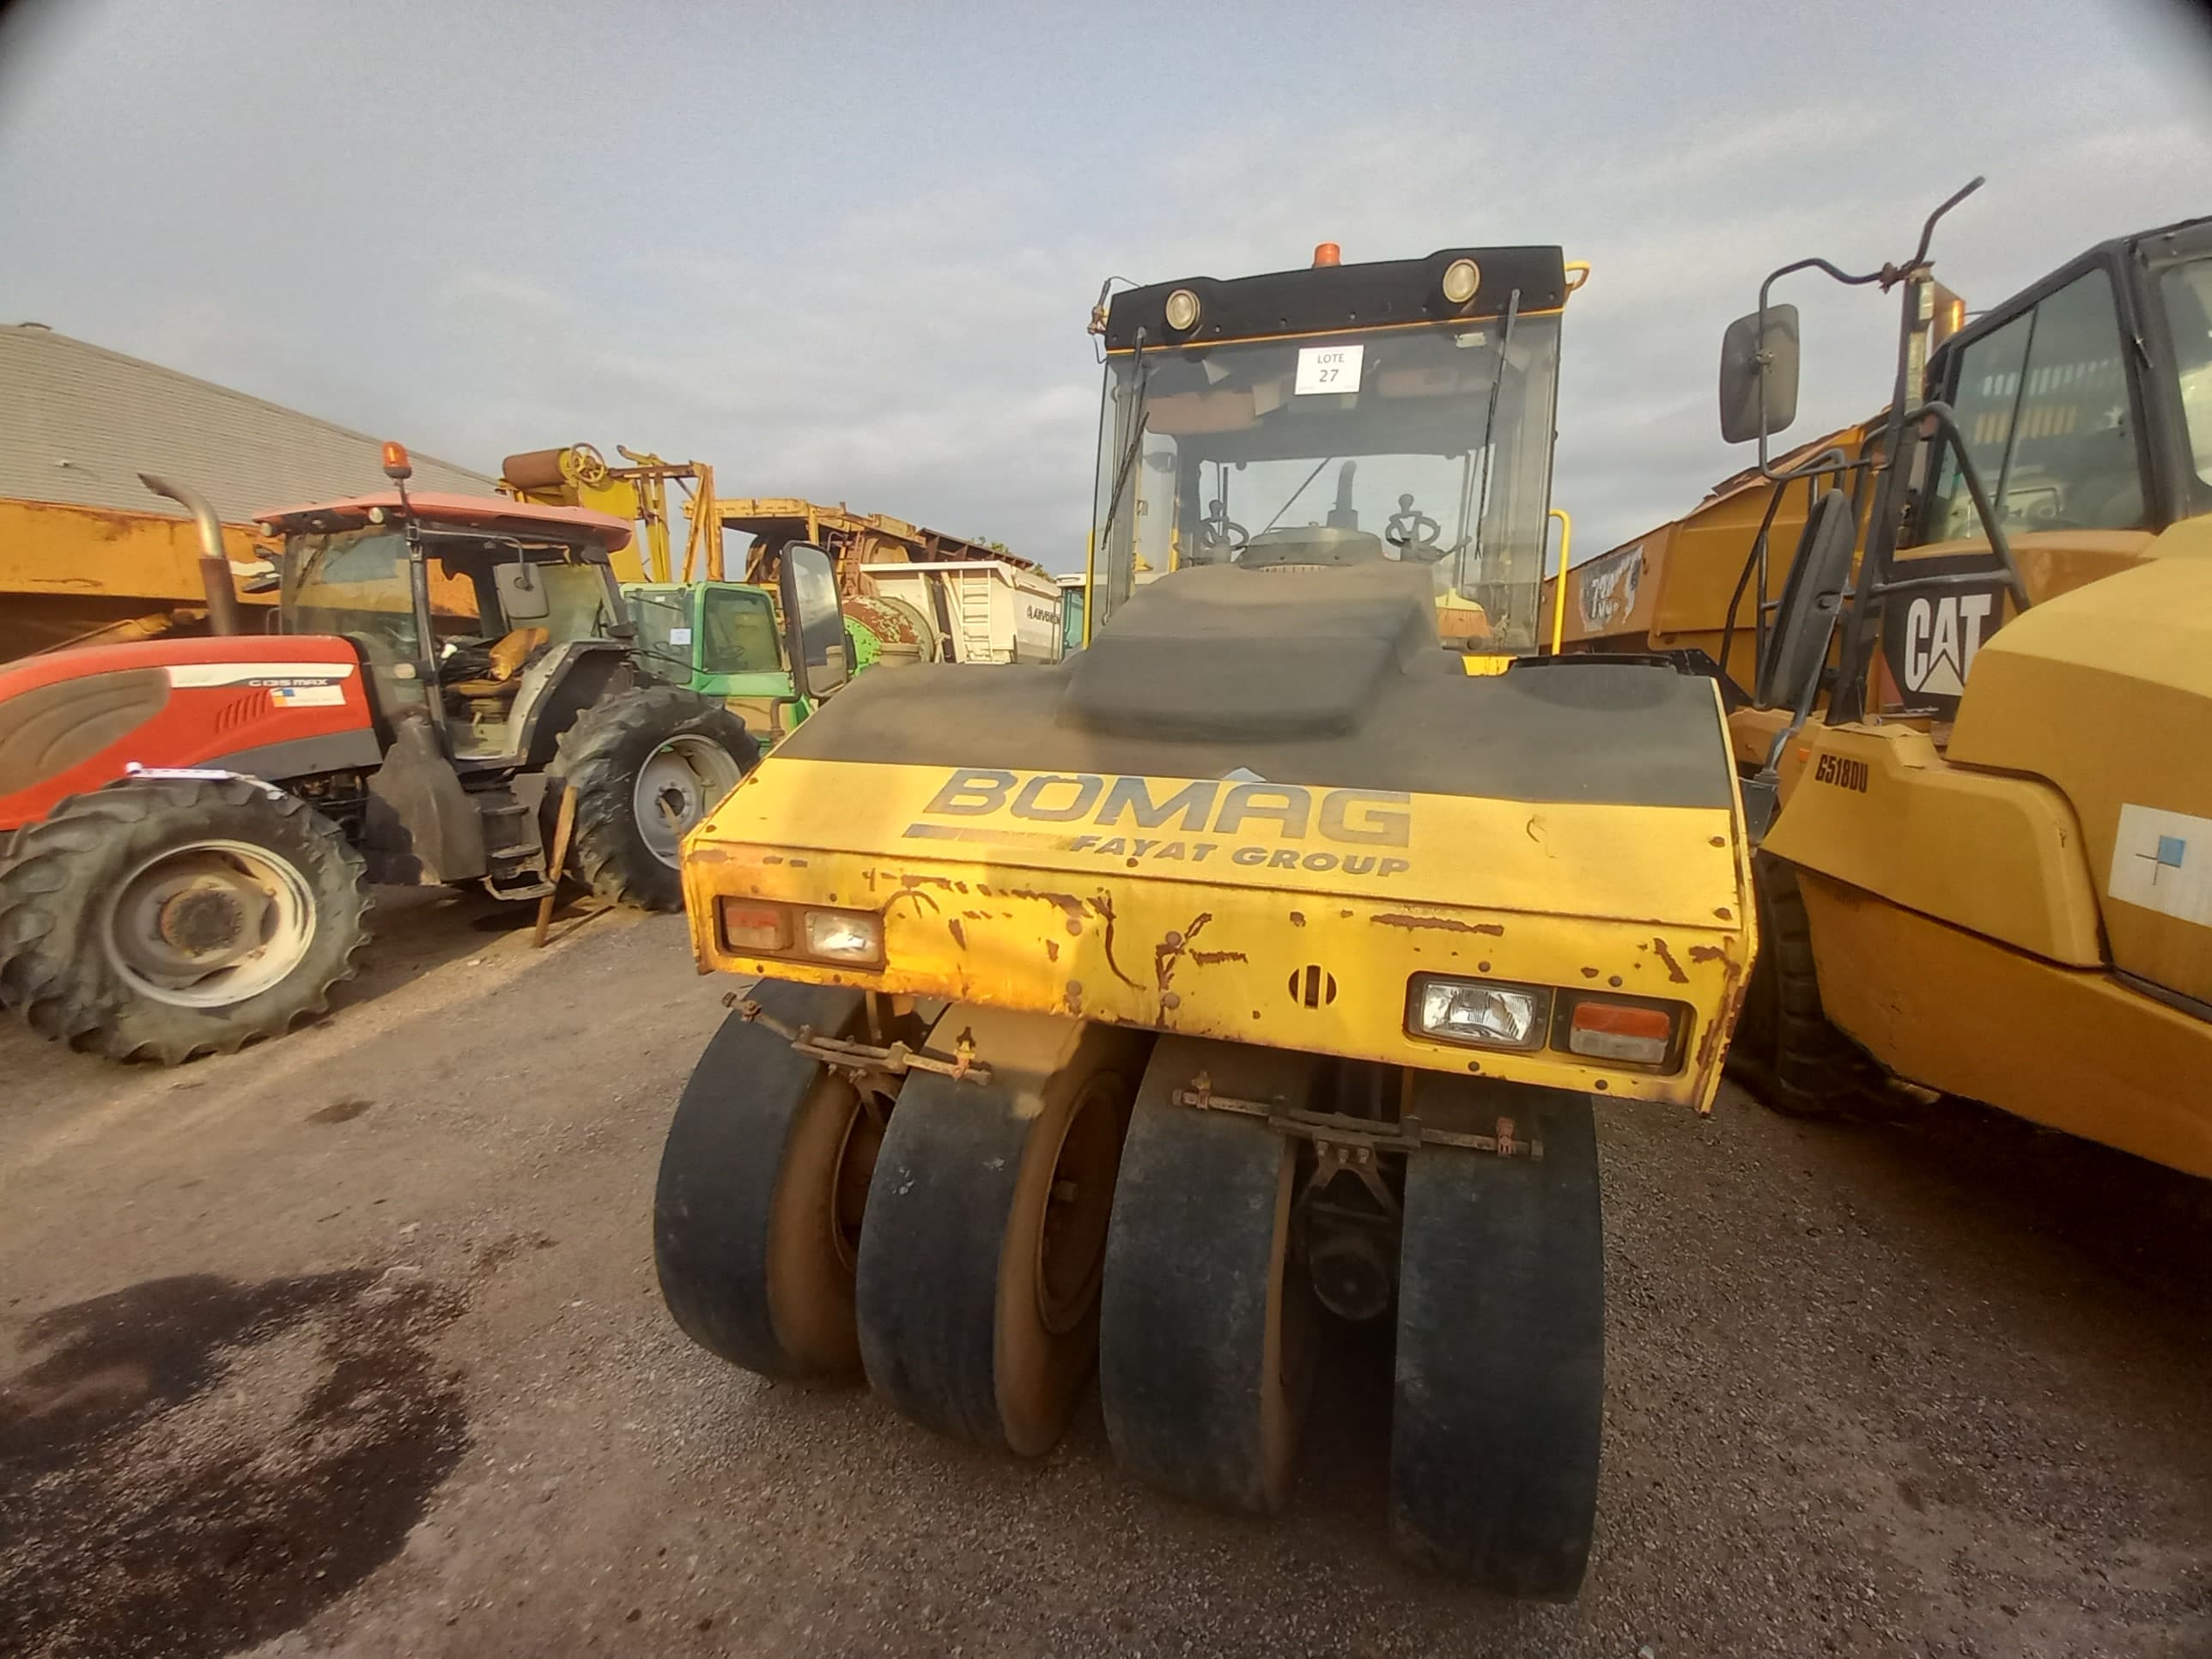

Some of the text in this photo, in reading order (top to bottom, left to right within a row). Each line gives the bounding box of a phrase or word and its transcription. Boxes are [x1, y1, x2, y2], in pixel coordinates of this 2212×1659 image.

[1317, 353, 1345, 364] LOTE
[1319, 369, 1340, 382] 27
[1905, 593, 1993, 692] CAT
[922, 769, 1411, 848] BOMAG
[1068, 835, 1411, 878] FAYAT GROUP
